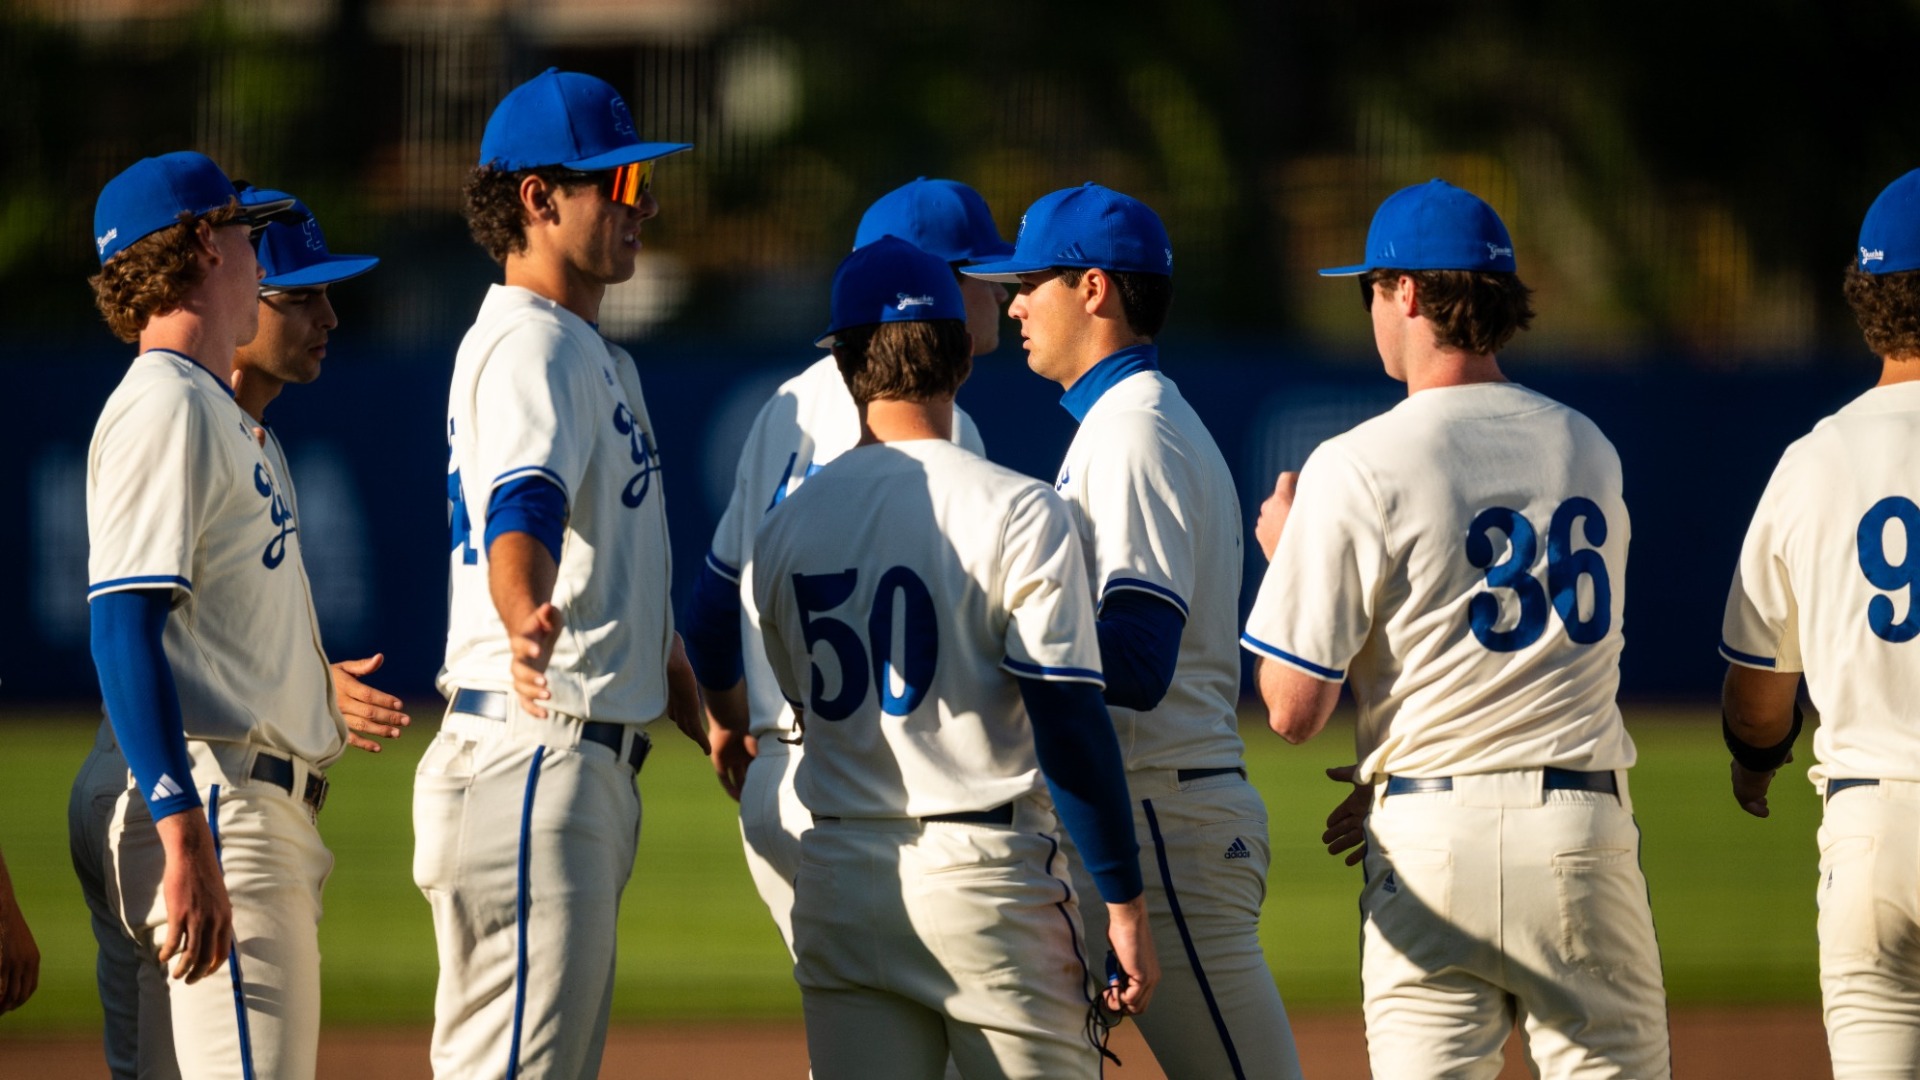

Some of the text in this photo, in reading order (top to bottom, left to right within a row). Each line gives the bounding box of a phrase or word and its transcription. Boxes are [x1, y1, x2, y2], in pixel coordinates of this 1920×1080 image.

[792, 565, 938, 721] 50
[1466, 496, 1612, 653] 36
[1857, 496, 1920, 643] 9
